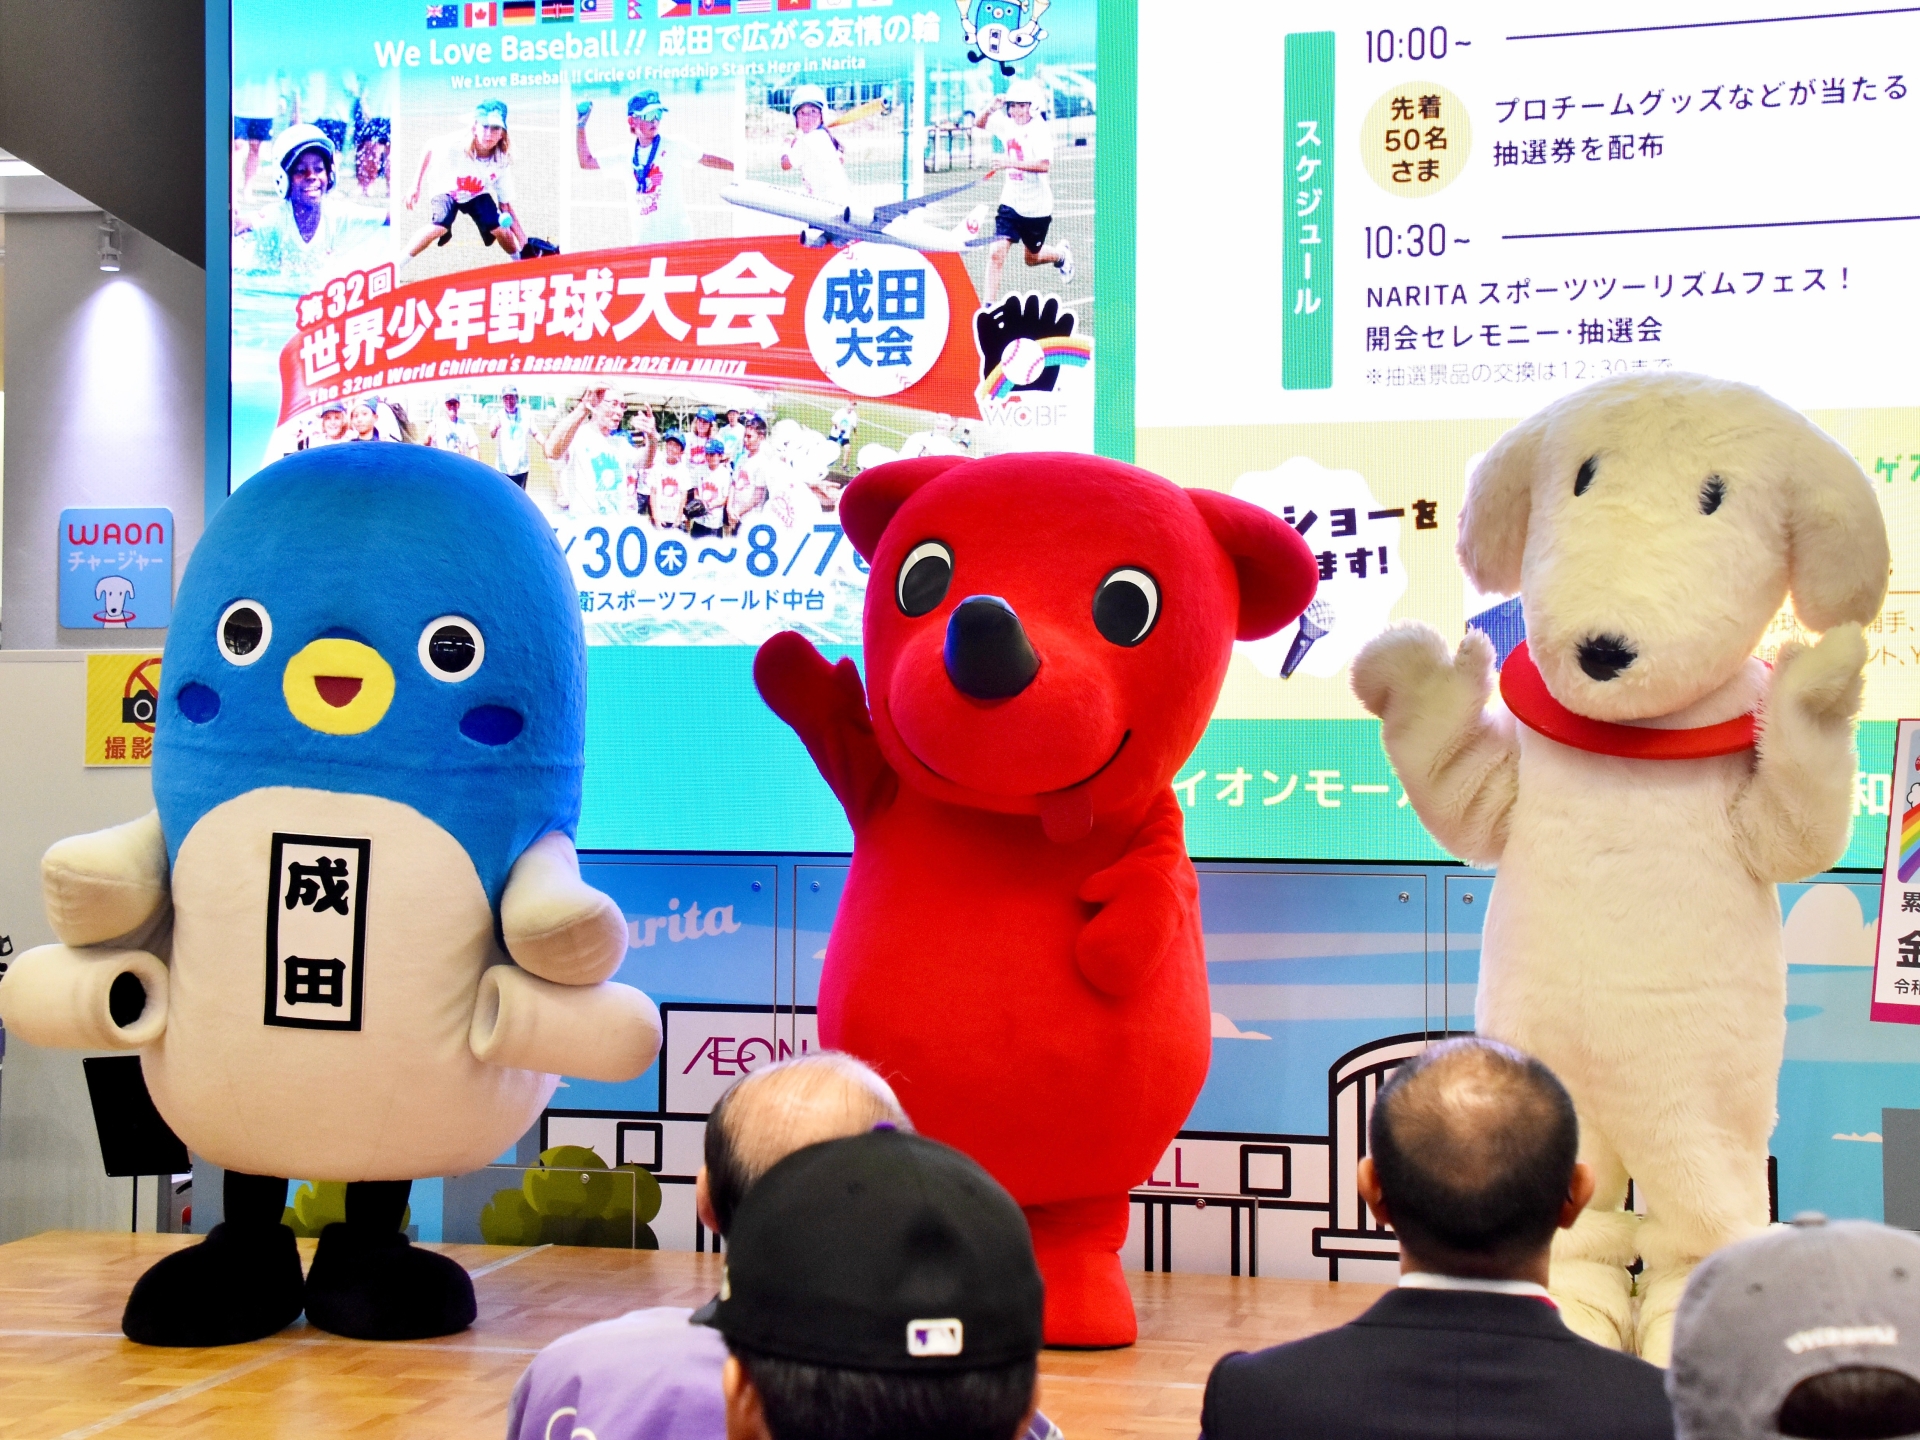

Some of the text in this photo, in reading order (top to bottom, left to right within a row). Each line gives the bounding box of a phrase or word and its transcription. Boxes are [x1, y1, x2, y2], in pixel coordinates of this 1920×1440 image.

[374, 40, 421, 68] We
[429, 38, 492, 66] Love
[658, 11, 941, 56] 成田で広がる友情の輪
[451, 75, 472, 89] We
[475, 74, 507, 88] Love
[584, 68, 624, 83] Circle
[627, 67, 642, 80] of
[645, 63, 719, 80] Friendship
[722, 61, 764, 76] Starts
[768, 59, 800, 74] Here
[804, 58, 818, 72] in
[821, 56, 866, 71] Narita
[1391, 94, 1442, 121] 先着
[1496, 75, 1907, 123] プロチームグッズなどが当たる
[1385, 126, 1447, 152] 50名
[1493, 132, 1664, 167] 抽選券を配布
[1391, 158, 1440, 184] さま
[1294, 121, 1323, 315] スケジュール
[300, 266, 392, 327] 第32回
[822, 268, 925, 325] 成田
[1367, 284, 1468, 308] NARITA
[300, 251, 795, 386] 世界少年野球大会
[836, 326, 914, 368] 大会
[309, 353, 748, 405] The 32nd World Children's Baseball Fair 2026 in NARITA
[984, 404, 1067, 427] WCBF
[68, 523, 164, 546] WAON
[68, 551, 164, 572] チャージャー
[104, 736, 152, 760] 撮影
[1172, 766, 1409, 808] イオンモー
[284, 856, 349, 1007] 成田
